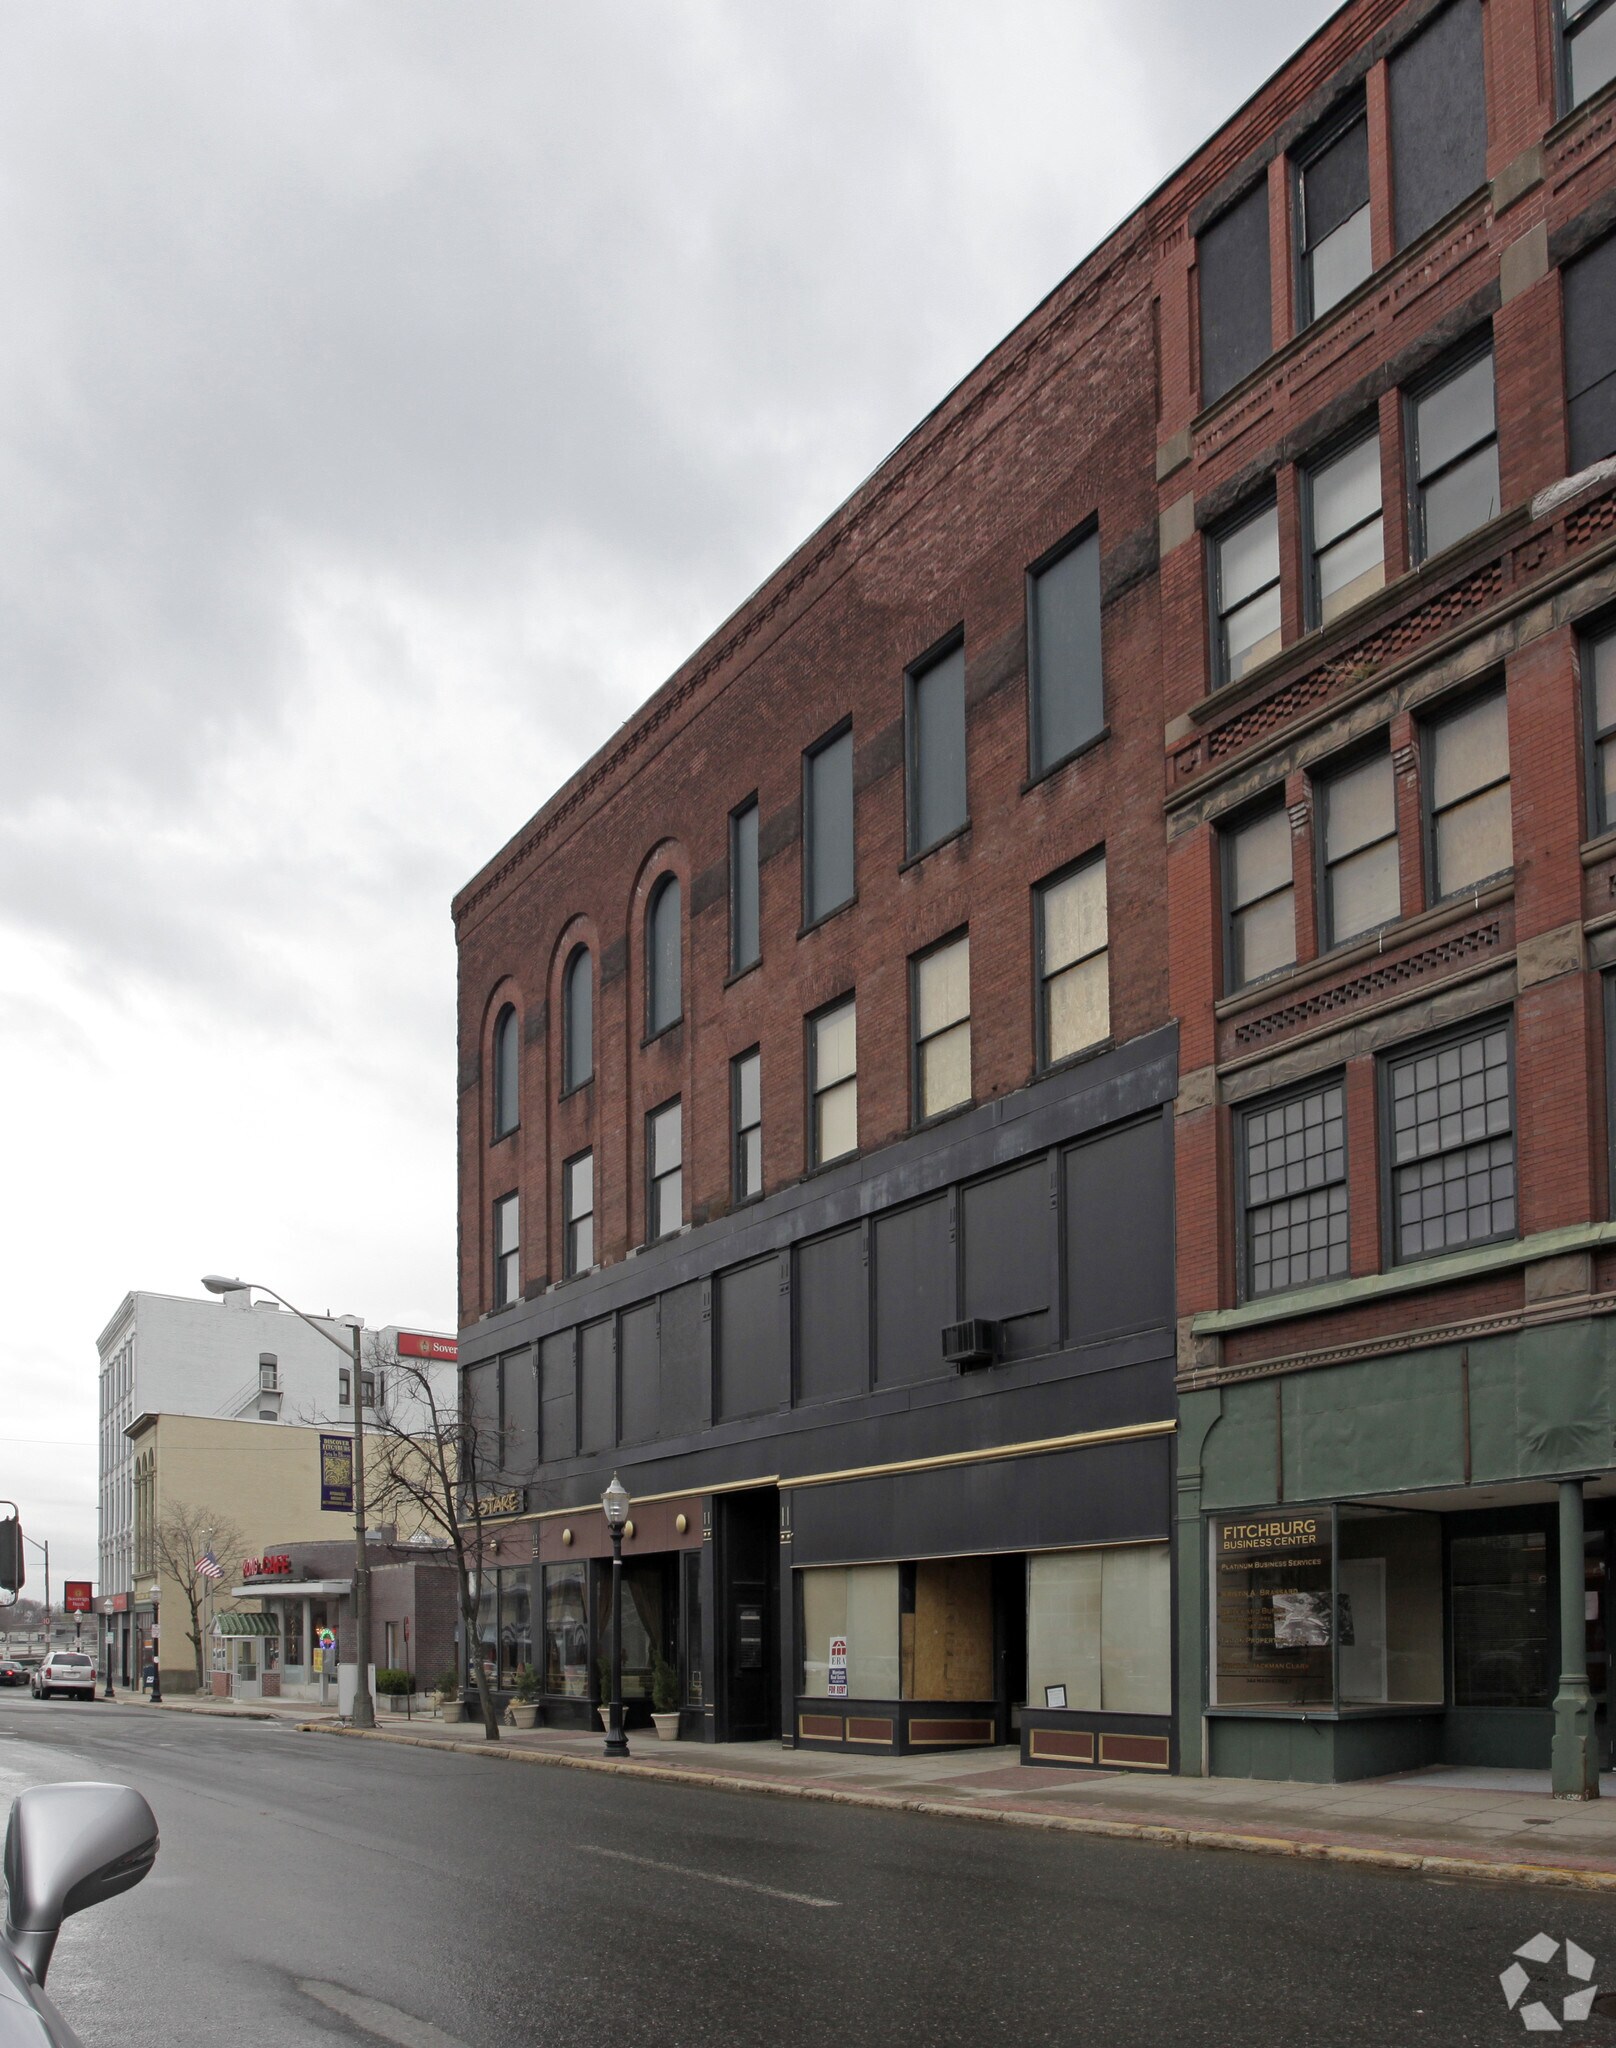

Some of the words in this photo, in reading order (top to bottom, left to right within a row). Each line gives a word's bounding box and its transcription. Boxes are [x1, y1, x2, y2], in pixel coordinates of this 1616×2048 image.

[433, 1342, 458, 1354] Sover
[1223, 1519, 1316, 1540] FITCHBURG
[1223, 1538, 1272, 1550] BUSINESS
[1273, 1534, 1316, 1546] CENTER
[263, 1554, 289, 1574] CAFE
[1221, 1562, 1253, 1572] PLATINUM
[1254, 1560, 1287, 1569] BUSINESS
[1288, 1558, 1322, 1567] SERVICES
[832, 1657, 846, 1665] ERA
[828, 1685, 836, 1694] FOR
[836, 1685, 846, 1694] RENT
